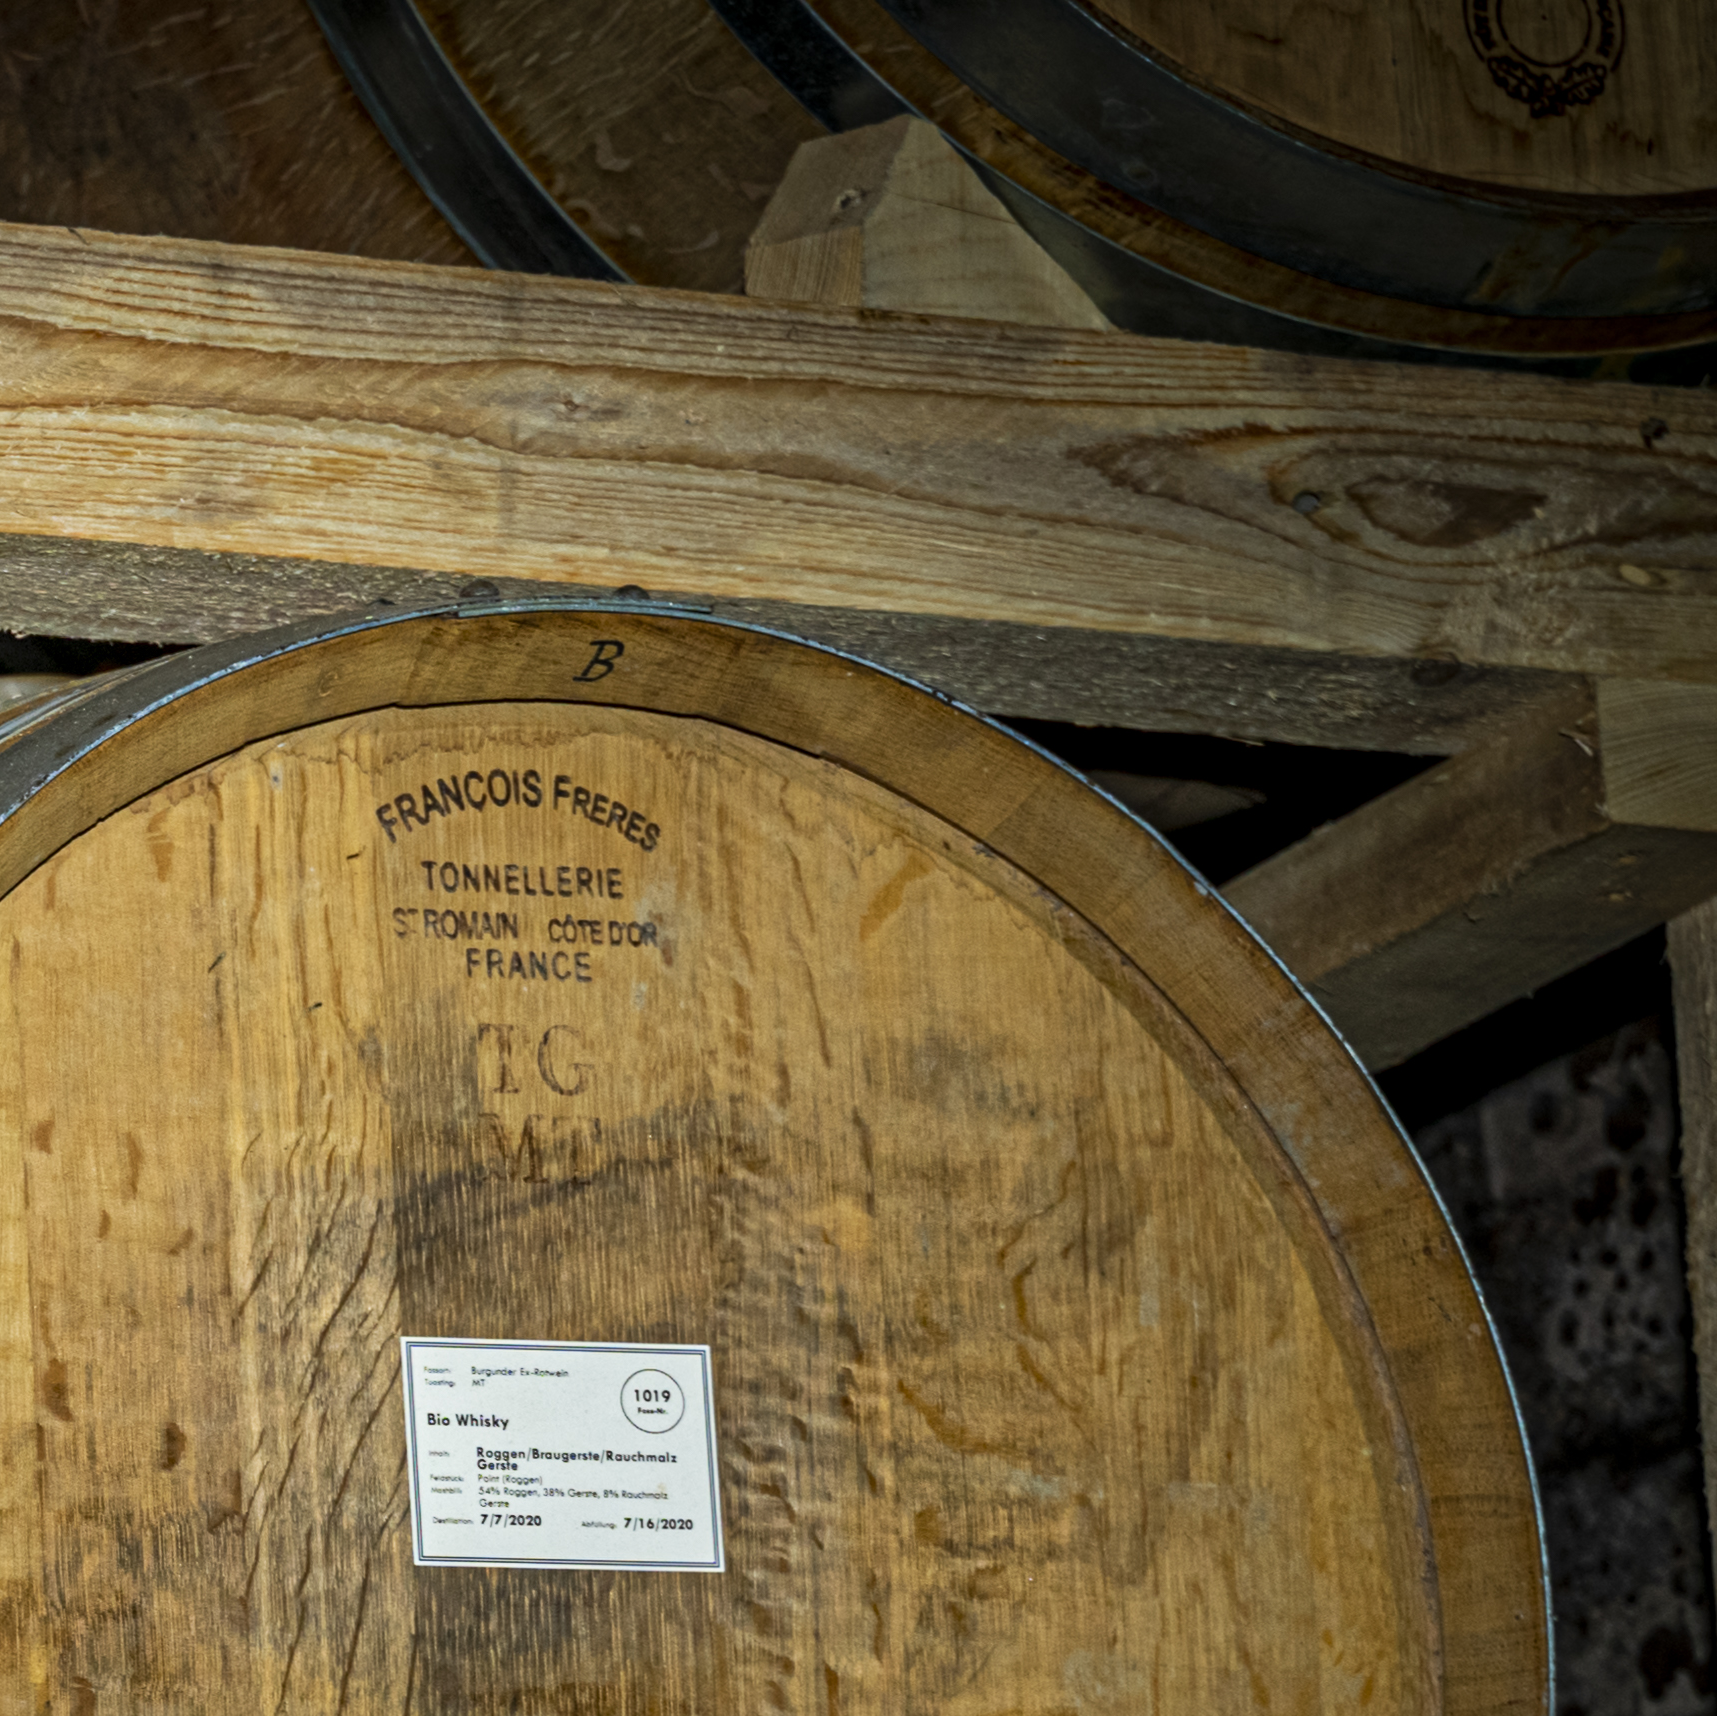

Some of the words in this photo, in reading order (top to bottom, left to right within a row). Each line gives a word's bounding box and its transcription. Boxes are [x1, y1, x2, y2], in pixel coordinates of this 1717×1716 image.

[572, 639, 626, 683] B
[553, 774, 662, 853] FRERES
[420, 860, 625, 900] TONNELLERIE
[466, 948, 593, 983] FRANCE
[471, 1366, 517, 1377] Burgunder
[472, 1378, 485, 1387] MT
[634, 1389, 671, 1402] 1019
[427, 1413, 450, 1426] Bio
[456, 1414, 509, 1431] Whisky
[477, 1459, 518, 1471] Gerste
[503, 1474, 543, 1486] (Roggen)
[478, 1486, 501, 1496] 54%
[504, 1487, 540, 1498] Roggen,
[543, 1487, 565, 1497] 38%
[621, 1489, 669, 1500] Rauchmalz
[479, 1498, 510, 1508] Gerste
[480, 1513, 542, 1528] 7/7/2020
[624, 1517, 694, 1532] 7/16/2020
